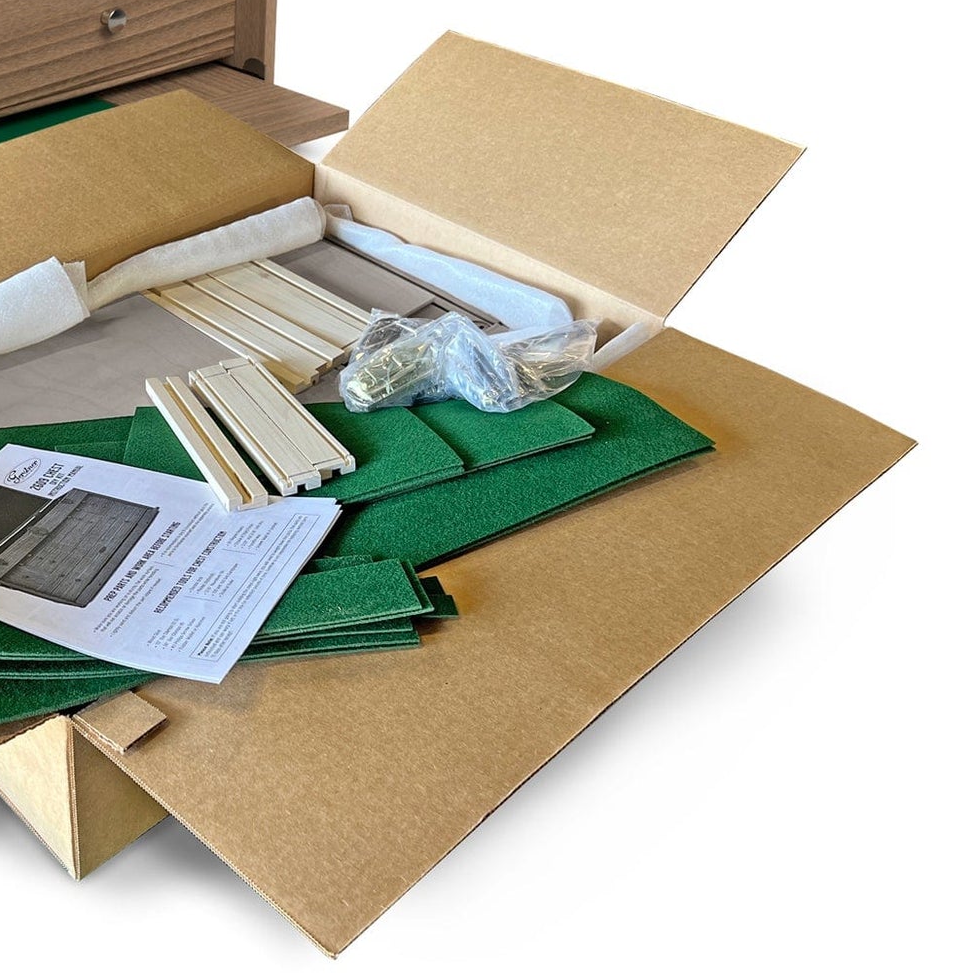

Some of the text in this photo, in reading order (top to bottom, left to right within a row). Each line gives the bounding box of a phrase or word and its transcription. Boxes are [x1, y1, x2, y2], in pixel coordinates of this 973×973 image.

[7, 460, 38, 484] Gerstner
[43, 463, 64, 478] CHEST
[104, 521, 181, 601] PREP PARTS AND WORK AREA BEFORE STARTING
[153, 585, 182, 614] RECOMMENDED
[176, 573, 192, 586] TOOLS
[186, 566, 198, 574] FOR
[192, 555, 207, 566] CHEST
[201, 530, 227, 555] CONSTRUCTION
